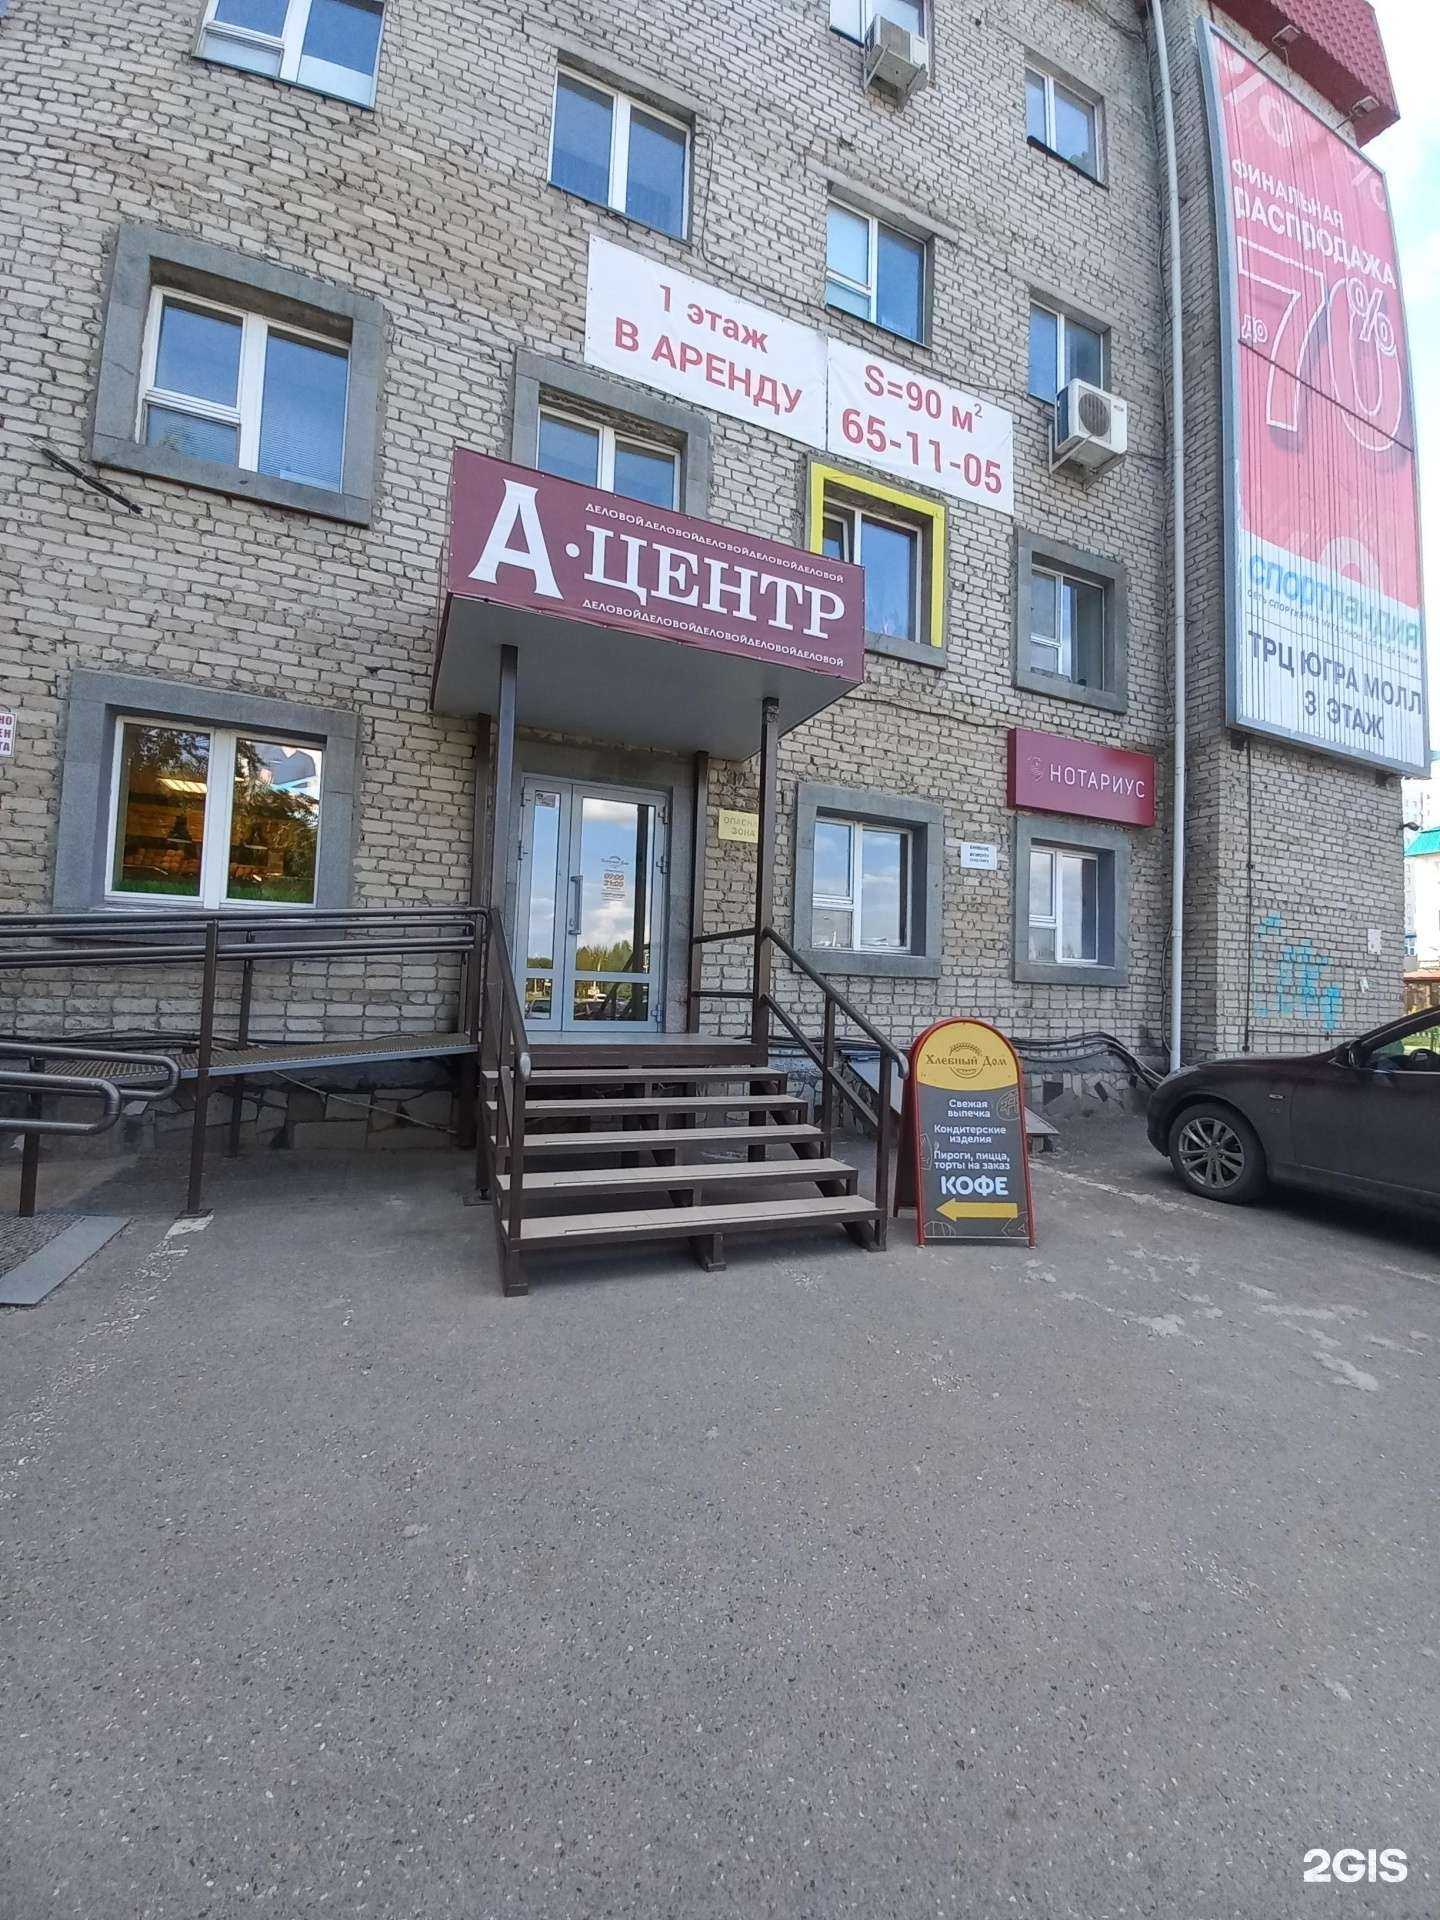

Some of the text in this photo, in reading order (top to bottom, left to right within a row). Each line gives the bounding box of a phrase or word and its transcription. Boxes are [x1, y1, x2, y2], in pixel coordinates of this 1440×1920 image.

[659, 285, 768, 354] 1 этаж
[614, 317, 802, 415] В АРЕНДУ
[864, 364, 941, 419] S=90
[841, 407, 1002, 494] 65-11-05
[1248, 630, 1295, 679] ТРЦ
[1301, 649, 1359, 693] ЮГРА
[1363, 674, 1422, 715] МОЛЛ
[1304, 690, 1384, 740] 3 ЭТАЖ
[1049, 763, 1145, 798] НОТАРИУС
[926, 1054, 1008, 1067] Хлебный Дом
[947, 1110, 991, 1118] выпечка
[949, 1099, 988, 1109] Свежая
[934, 1124, 1007, 1135] Кондитерские
[949, 1136, 992, 1145] изделия
[933, 1150, 1010, 1162] Пироги, пицца,
[934, 1162, 1011, 1171] торты на заказ
[940, 1175, 1009, 1196] КОФЕ
